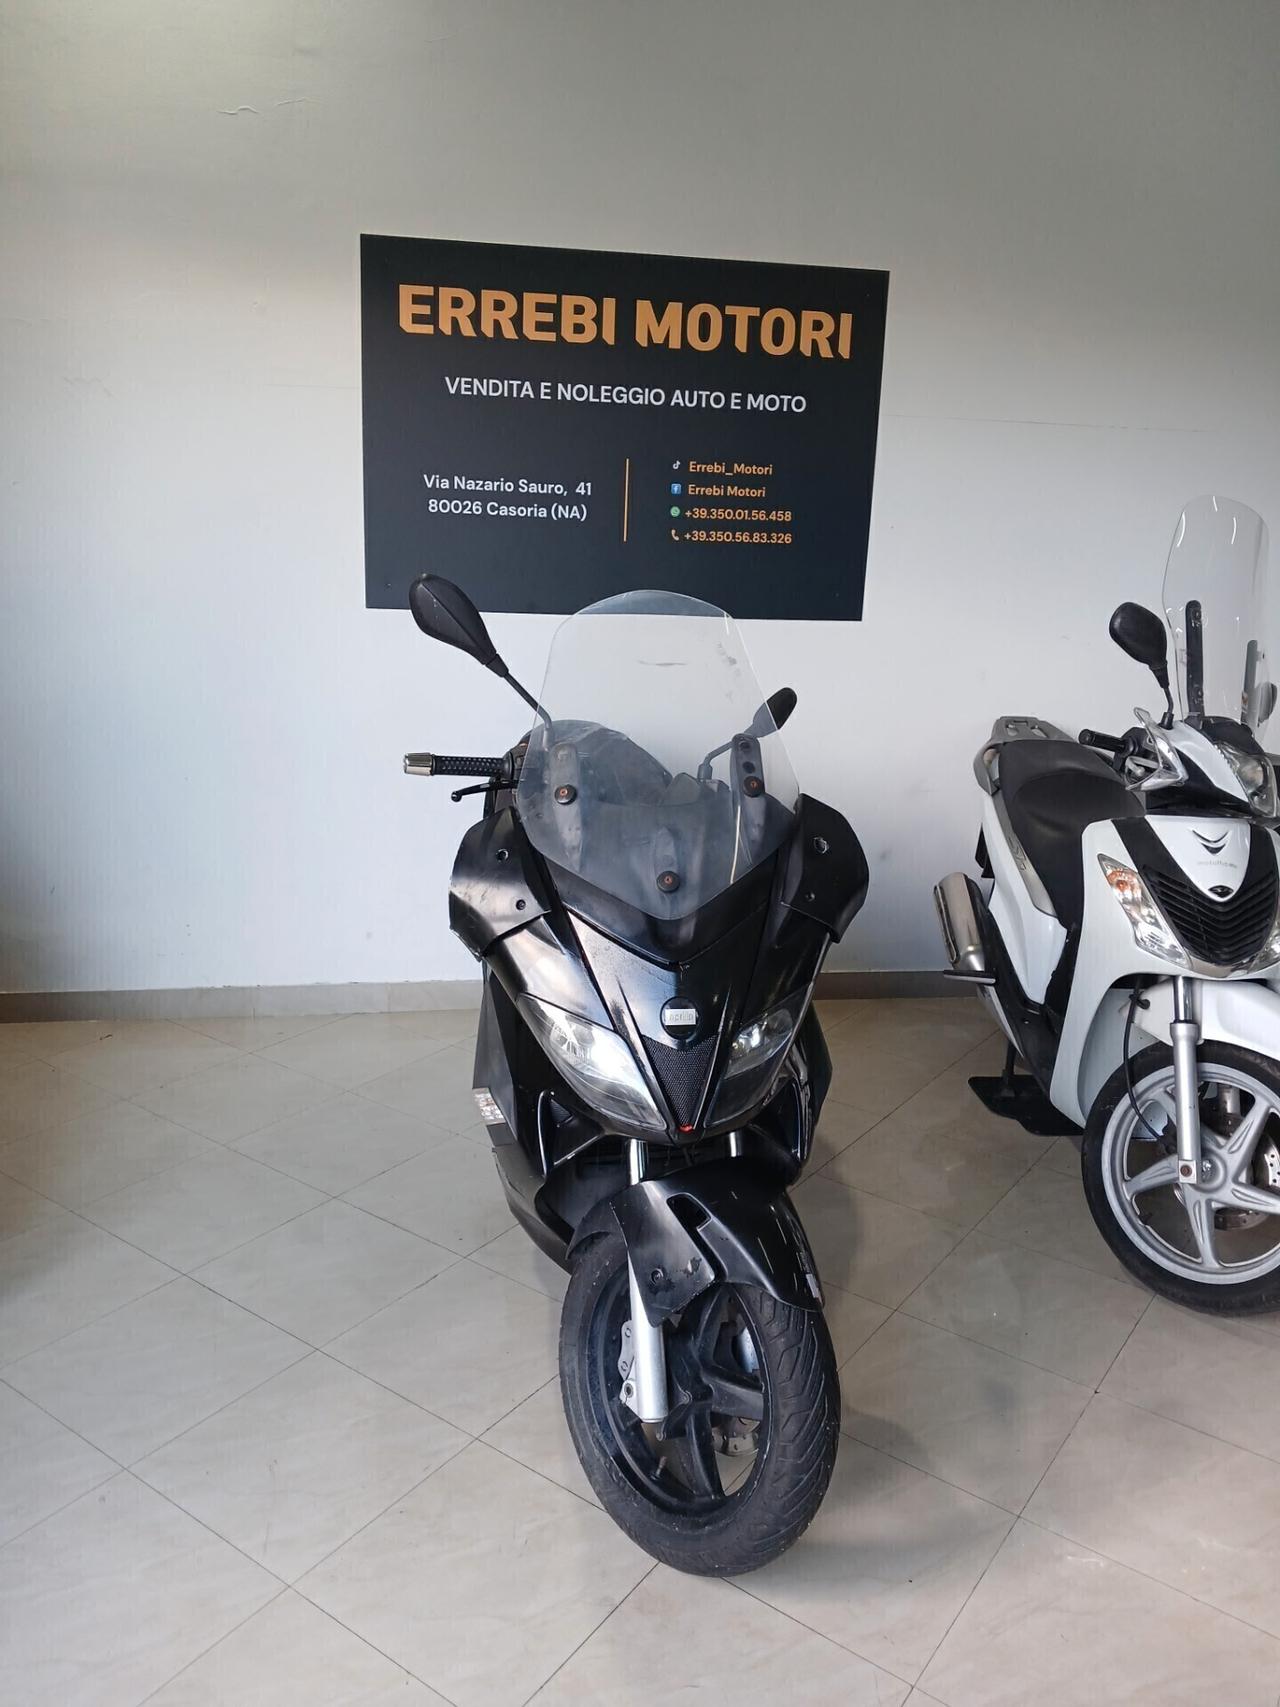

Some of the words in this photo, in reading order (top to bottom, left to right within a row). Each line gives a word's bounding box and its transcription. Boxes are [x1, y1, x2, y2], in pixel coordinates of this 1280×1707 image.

[398, 284, 616, 346] ERREBI
[635, 299, 853, 359] MOTORI
[444, 376, 535, 399] VENDITA
[539, 381, 552, 400] E
[557, 382, 666, 406] NOLEGGIO
[670, 389, 726, 409] AUTO
[730, 392, 743, 410] E
[746, 393, 807, 413] MOTO
[688, 460, 773, 476] Errebi_Motori
[423, 473, 450, 490] Via
[453, 475, 515, 493] Nazario
[518, 478, 568, 497] Sauro,
[575, 481, 592, 496] 41
[687, 484, 725, 496] Errebi
[726, 485, 766, 498] Motori
[427, 498, 483, 515] 80026
[486, 501, 548, 518] Casoria
[550, 502, 588, 522] (NA)
[684, 507, 793, 522] +39.350.01.56.458
[683, 530, 793, 544] +39.350.56.83.326
